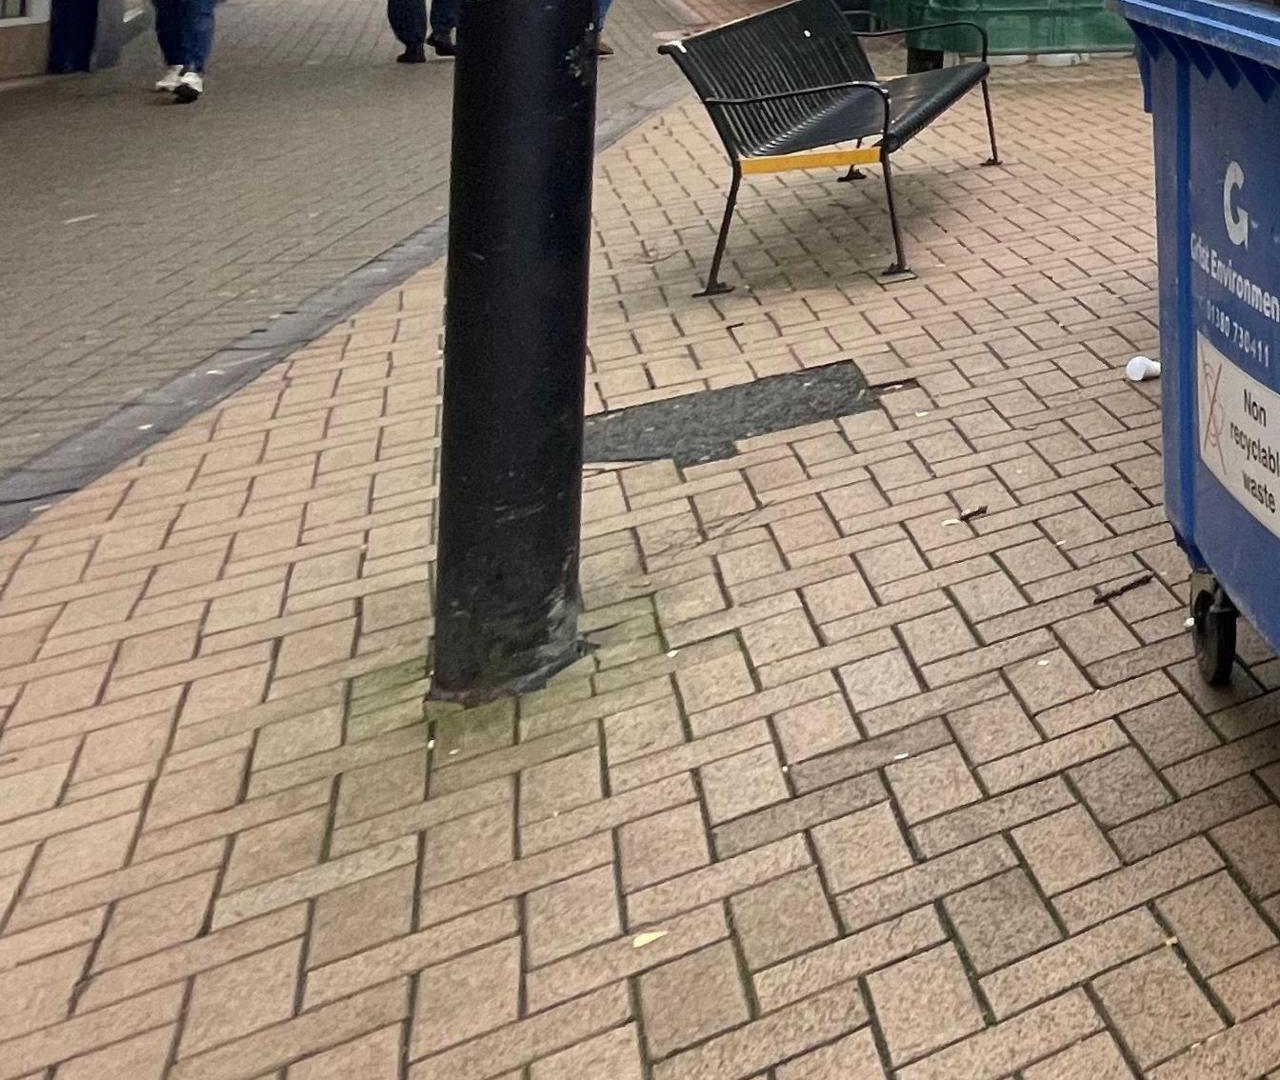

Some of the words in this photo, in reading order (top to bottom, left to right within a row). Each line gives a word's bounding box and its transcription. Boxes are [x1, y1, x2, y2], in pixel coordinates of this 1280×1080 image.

[1232, 321, 1269, 368] 730411
[1243, 388, 1267, 427] Non
[1242, 470, 1276, 514] waste
